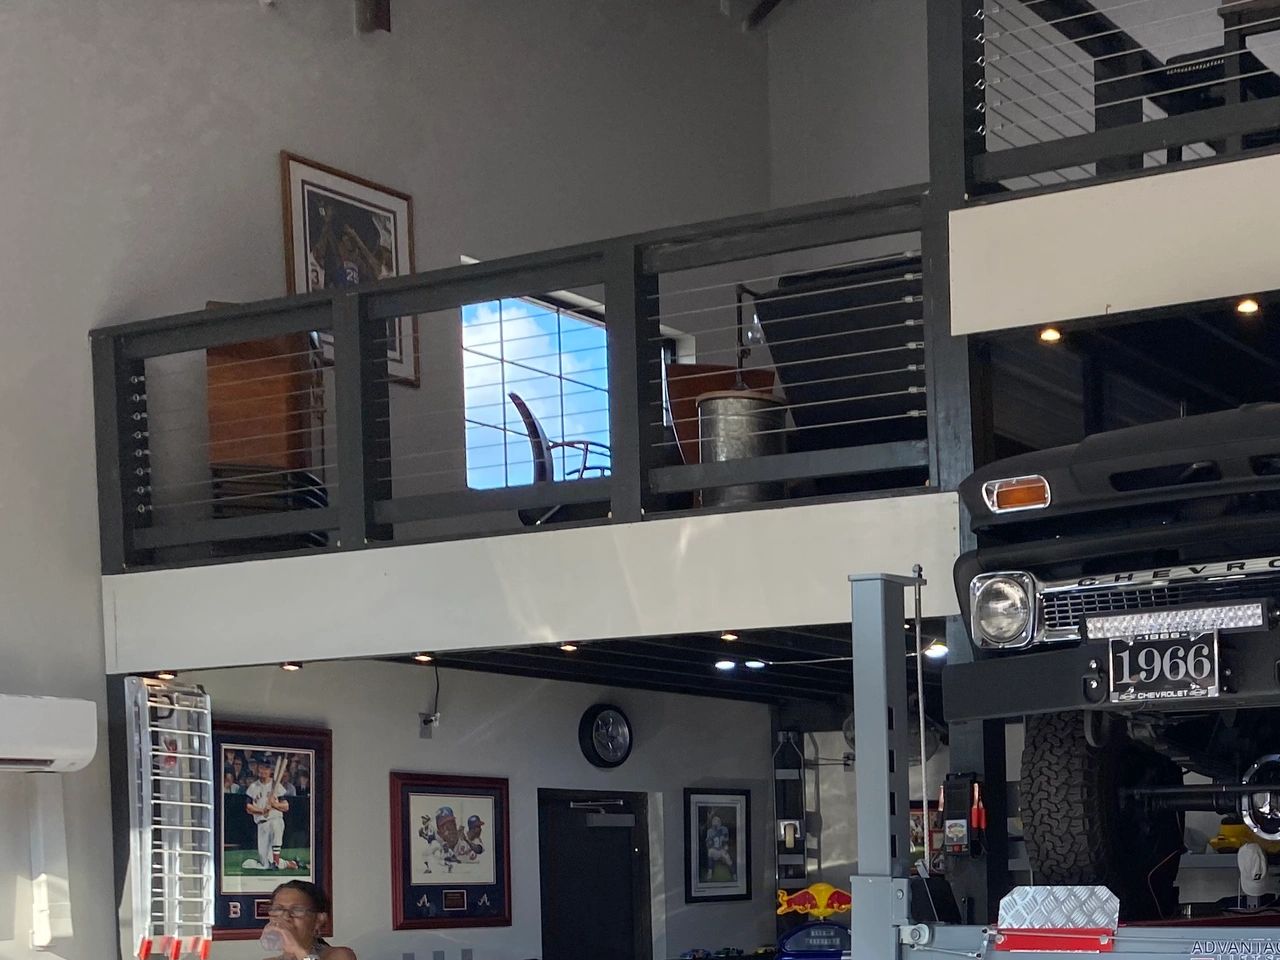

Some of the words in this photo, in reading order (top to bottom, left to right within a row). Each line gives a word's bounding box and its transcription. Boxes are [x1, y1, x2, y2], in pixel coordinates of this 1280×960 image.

[1116, 643, 1211, 685] 1966
[1137, 690, 1188, 699] CHEVROLET
[228, 901, 241, 918] B
